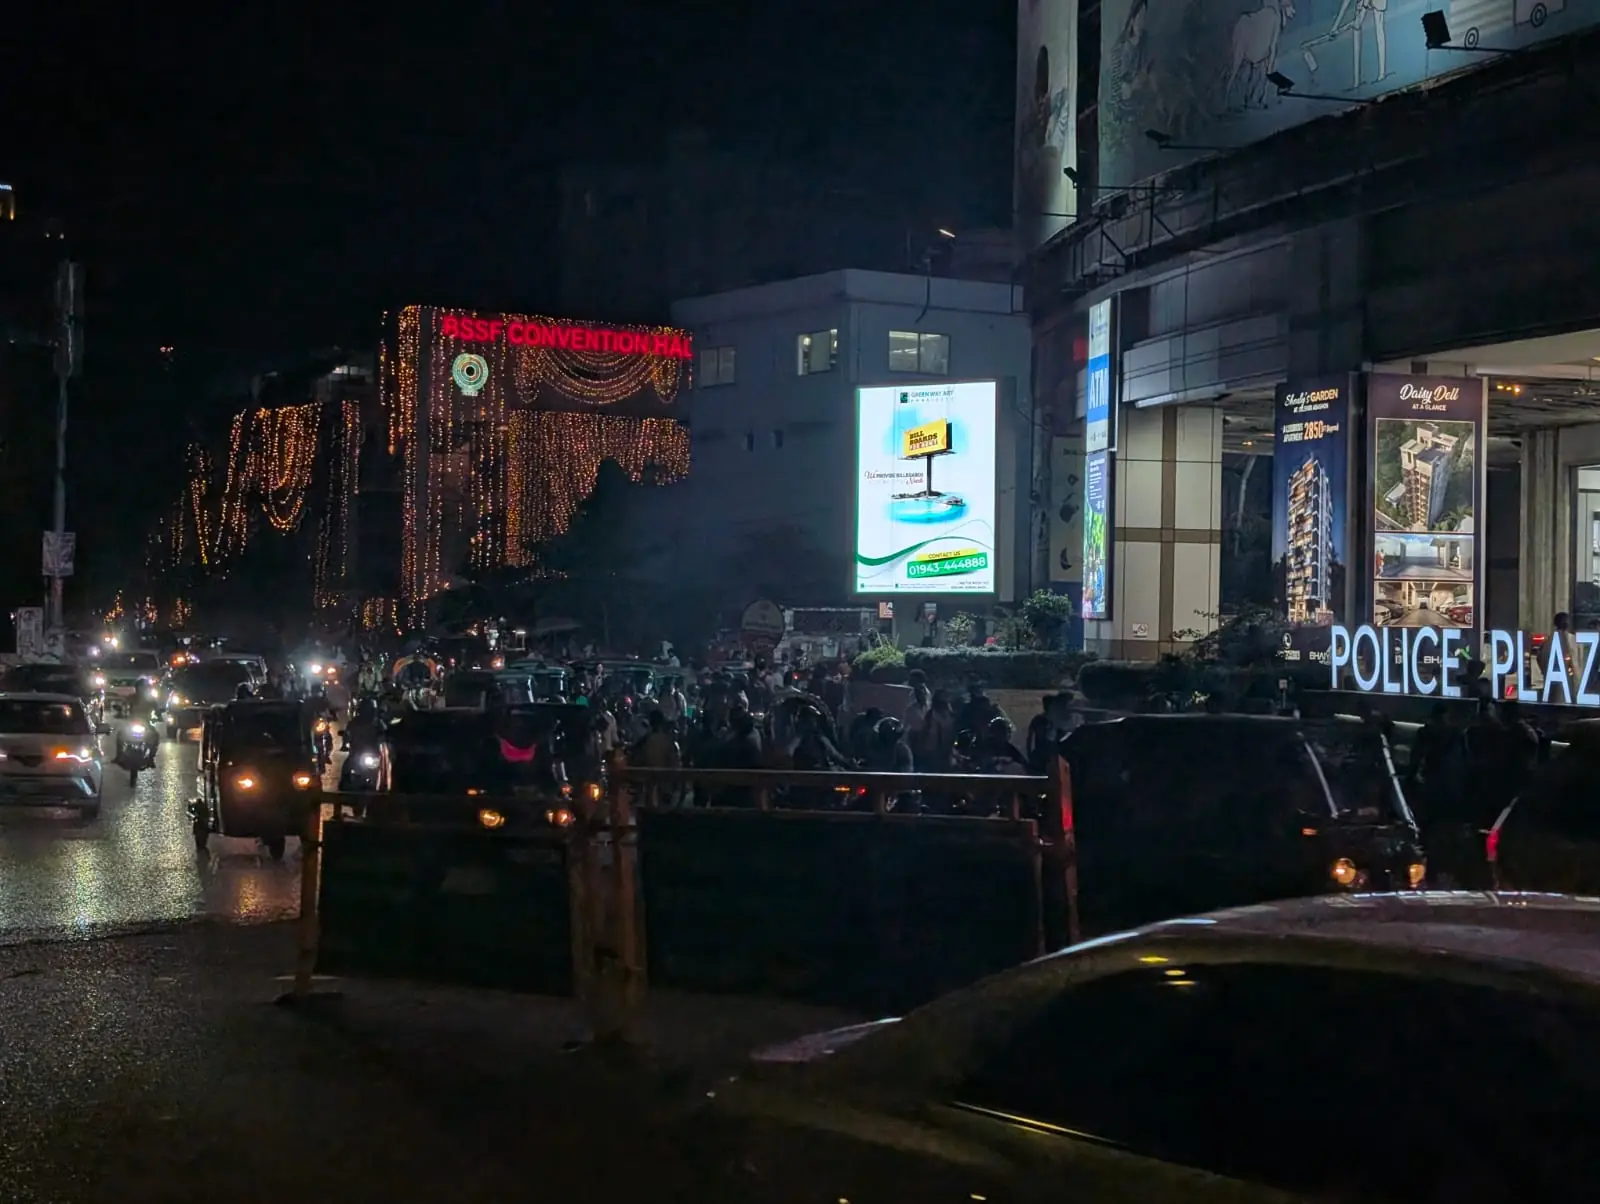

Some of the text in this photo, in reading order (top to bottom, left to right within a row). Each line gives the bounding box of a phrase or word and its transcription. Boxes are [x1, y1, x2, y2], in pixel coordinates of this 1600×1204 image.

[443, 316, 503, 343] BSSF
[507, 322, 650, 353] CONVENTION
[1089, 368, 1108, 410] ATM
[1310, 388, 1339, 402] GARDEN
[1400, 383, 1460, 404] Daisy Dell
[909, 432, 938, 445] BOARDS
[1330, 624, 1600, 705] POLICE PLAZ
